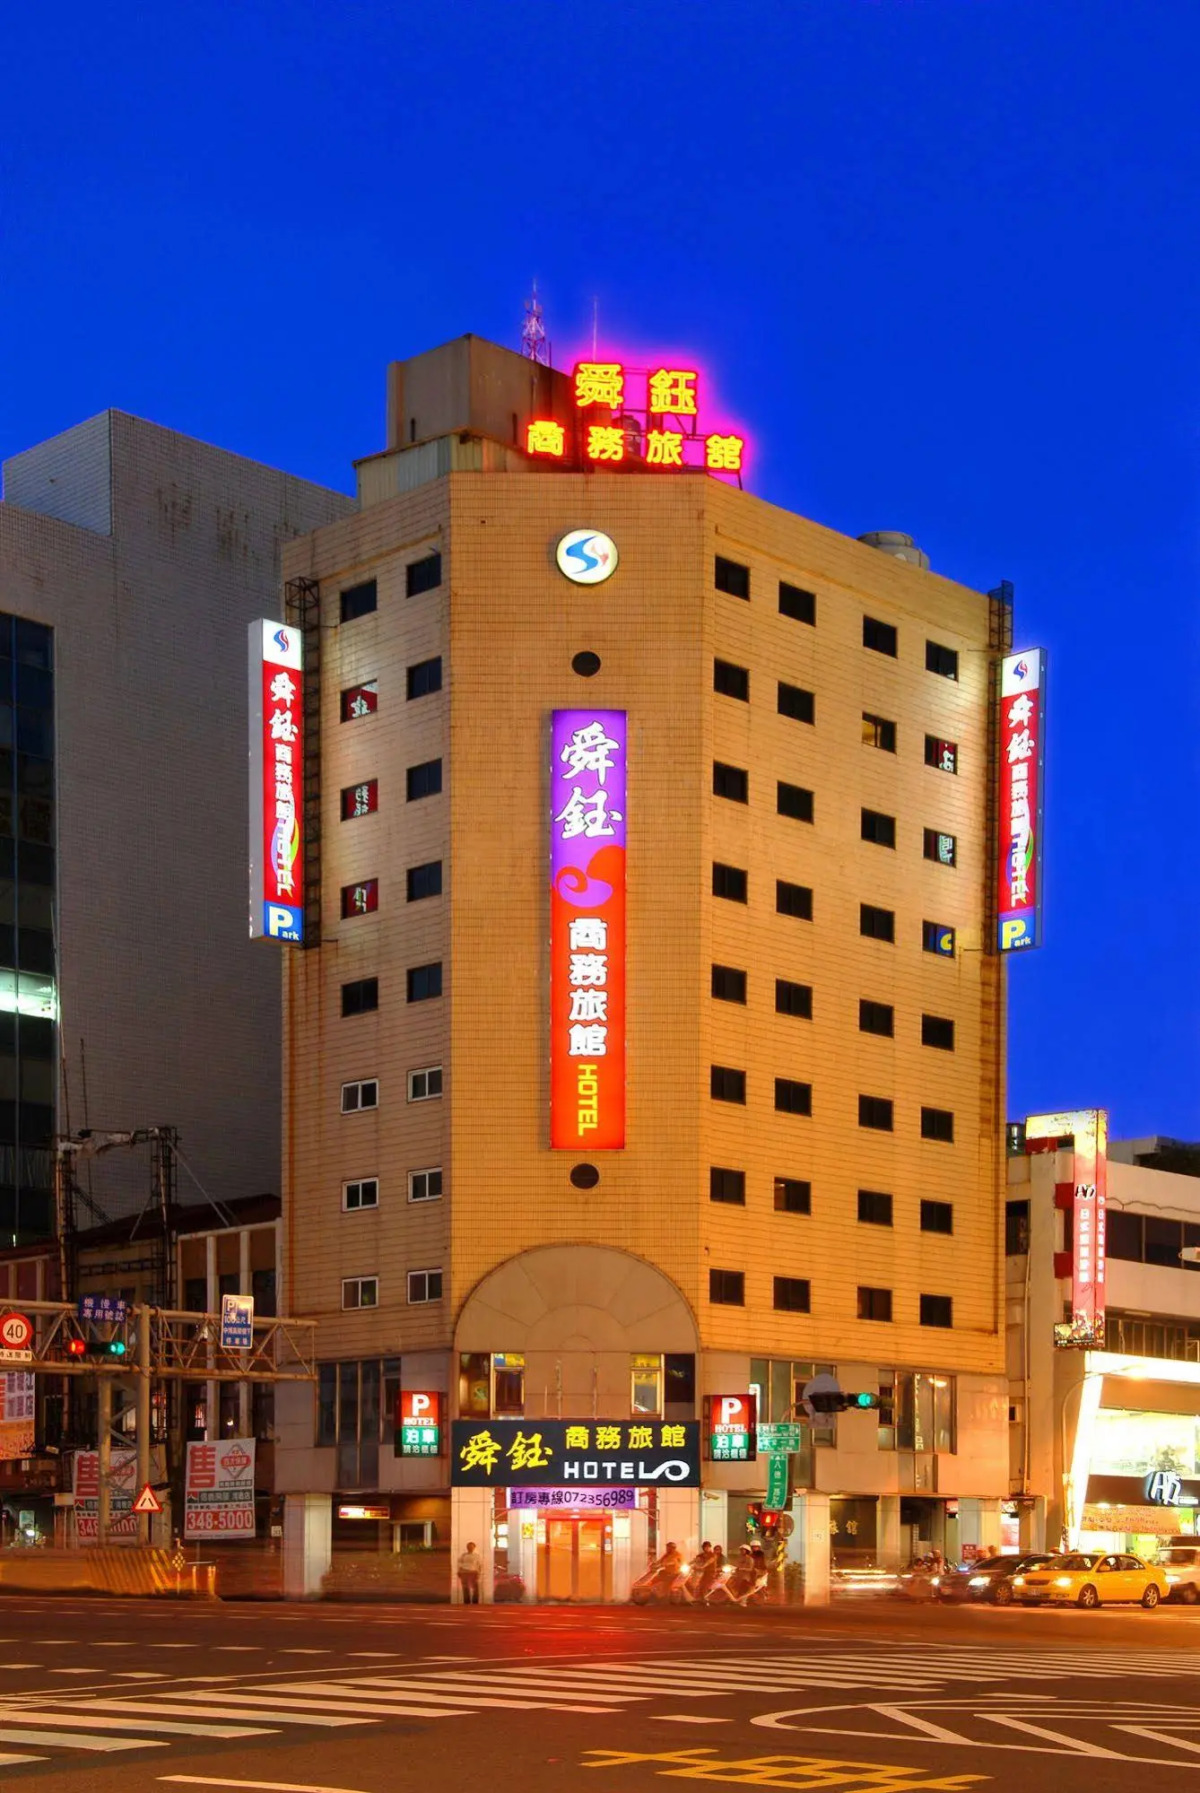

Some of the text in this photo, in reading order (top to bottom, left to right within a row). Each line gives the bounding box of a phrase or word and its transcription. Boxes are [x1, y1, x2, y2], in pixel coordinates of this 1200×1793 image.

[576, 363, 697, 414] 舜鈺
[269, 672, 298, 742] 舜鈺
[1006, 694, 1034, 764] 舜鈺
[554, 721, 623, 839] 舜鈺
[568, 917, 608, 1057] 商務旅館
[578, 1064, 598, 1136] HOTEL
[6, 1324, 24, 1339] 40
[412, 1394, 430, 1416] P
[715, 1424, 746, 1433] HOTEL
[721, 1398, 742, 1424] P
[460, 1430, 553, 1475] 舜鈺
[565, 1424, 687, 1449] 商務旅館
